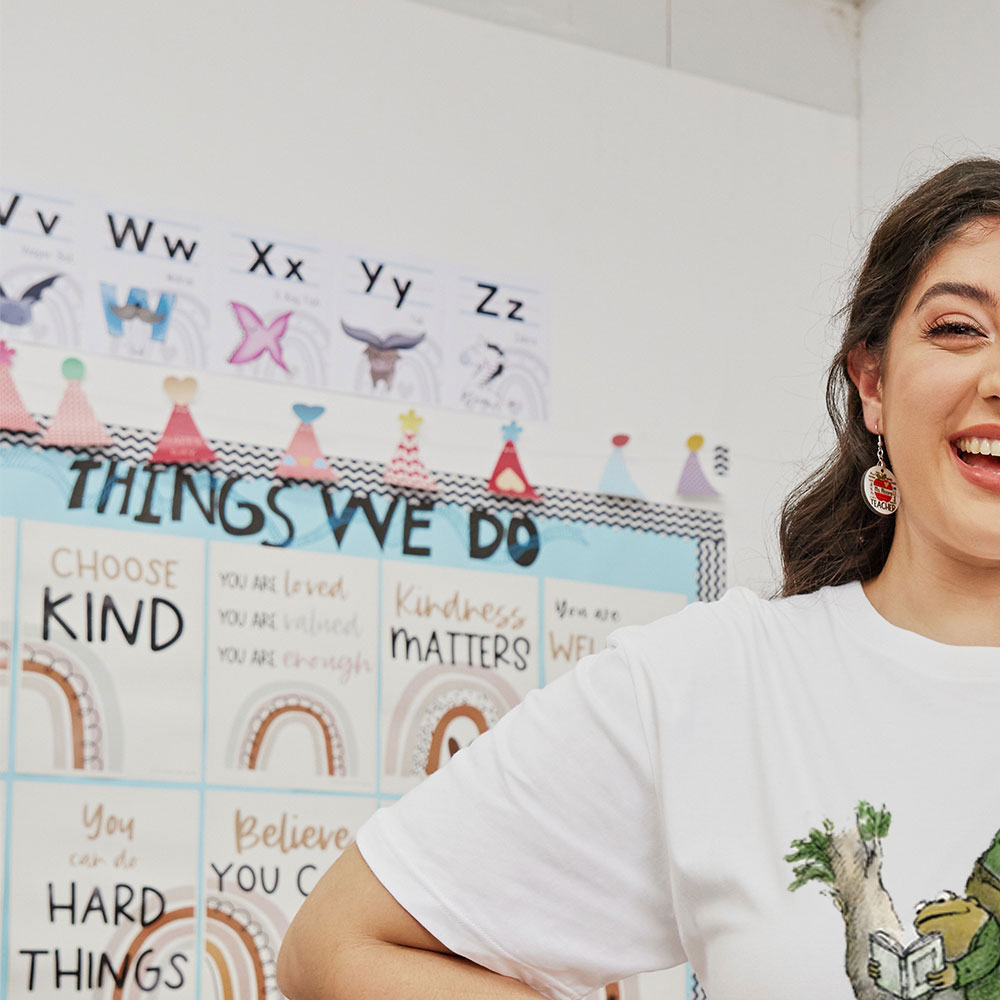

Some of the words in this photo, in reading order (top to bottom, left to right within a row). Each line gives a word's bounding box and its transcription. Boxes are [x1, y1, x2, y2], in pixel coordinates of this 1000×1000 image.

[36, 211, 59, 234] v
[107, 213, 154, 252] W
[163, 235, 198, 261] w
[249, 240, 274, 276] X
[285, 258, 304, 282] x
[361, 260, 384, 294] Y
[393, 277, 412, 309] y
[476, 283, 499, 317] Z
[507, 299, 525, 322] z
[67, 458, 295, 548] THINGS
[321, 486, 435, 557] WE
[469, 507, 541, 567] DO
[51, 548, 179, 589] CHOOSE
[284, 569, 348, 600] loved
[43, 586, 184, 652] KIND
[396, 583, 528, 630] Kindness
[82, 802, 136, 840] You
[235, 808, 350, 854] Believe
[210, 862, 280, 894] YOU
[48, 881, 165, 927] HARD
[19, 948, 189, 992] THINGS
